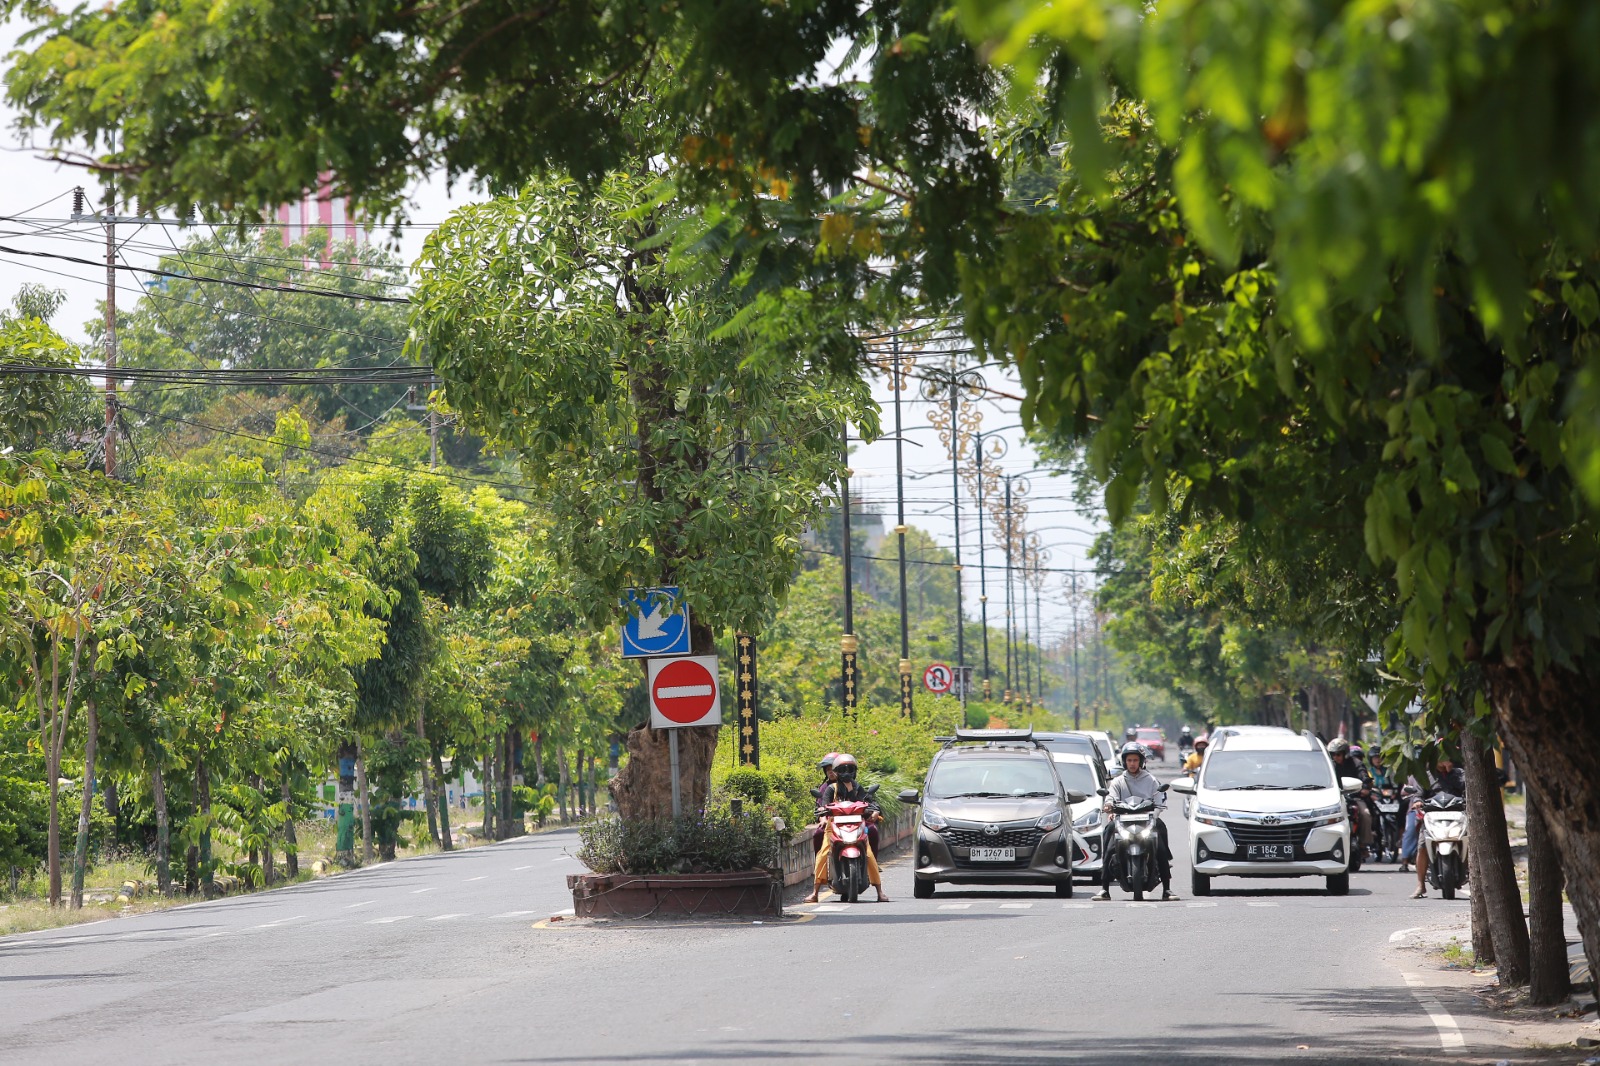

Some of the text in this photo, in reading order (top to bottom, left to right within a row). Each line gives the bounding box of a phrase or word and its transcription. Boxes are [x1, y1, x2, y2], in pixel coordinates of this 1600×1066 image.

[971, 849, 981, 857] BM
[984, 849, 1002, 857] 1767
[1248, 845, 1257, 854] AE
[1261, 845, 1277, 854] 1642
